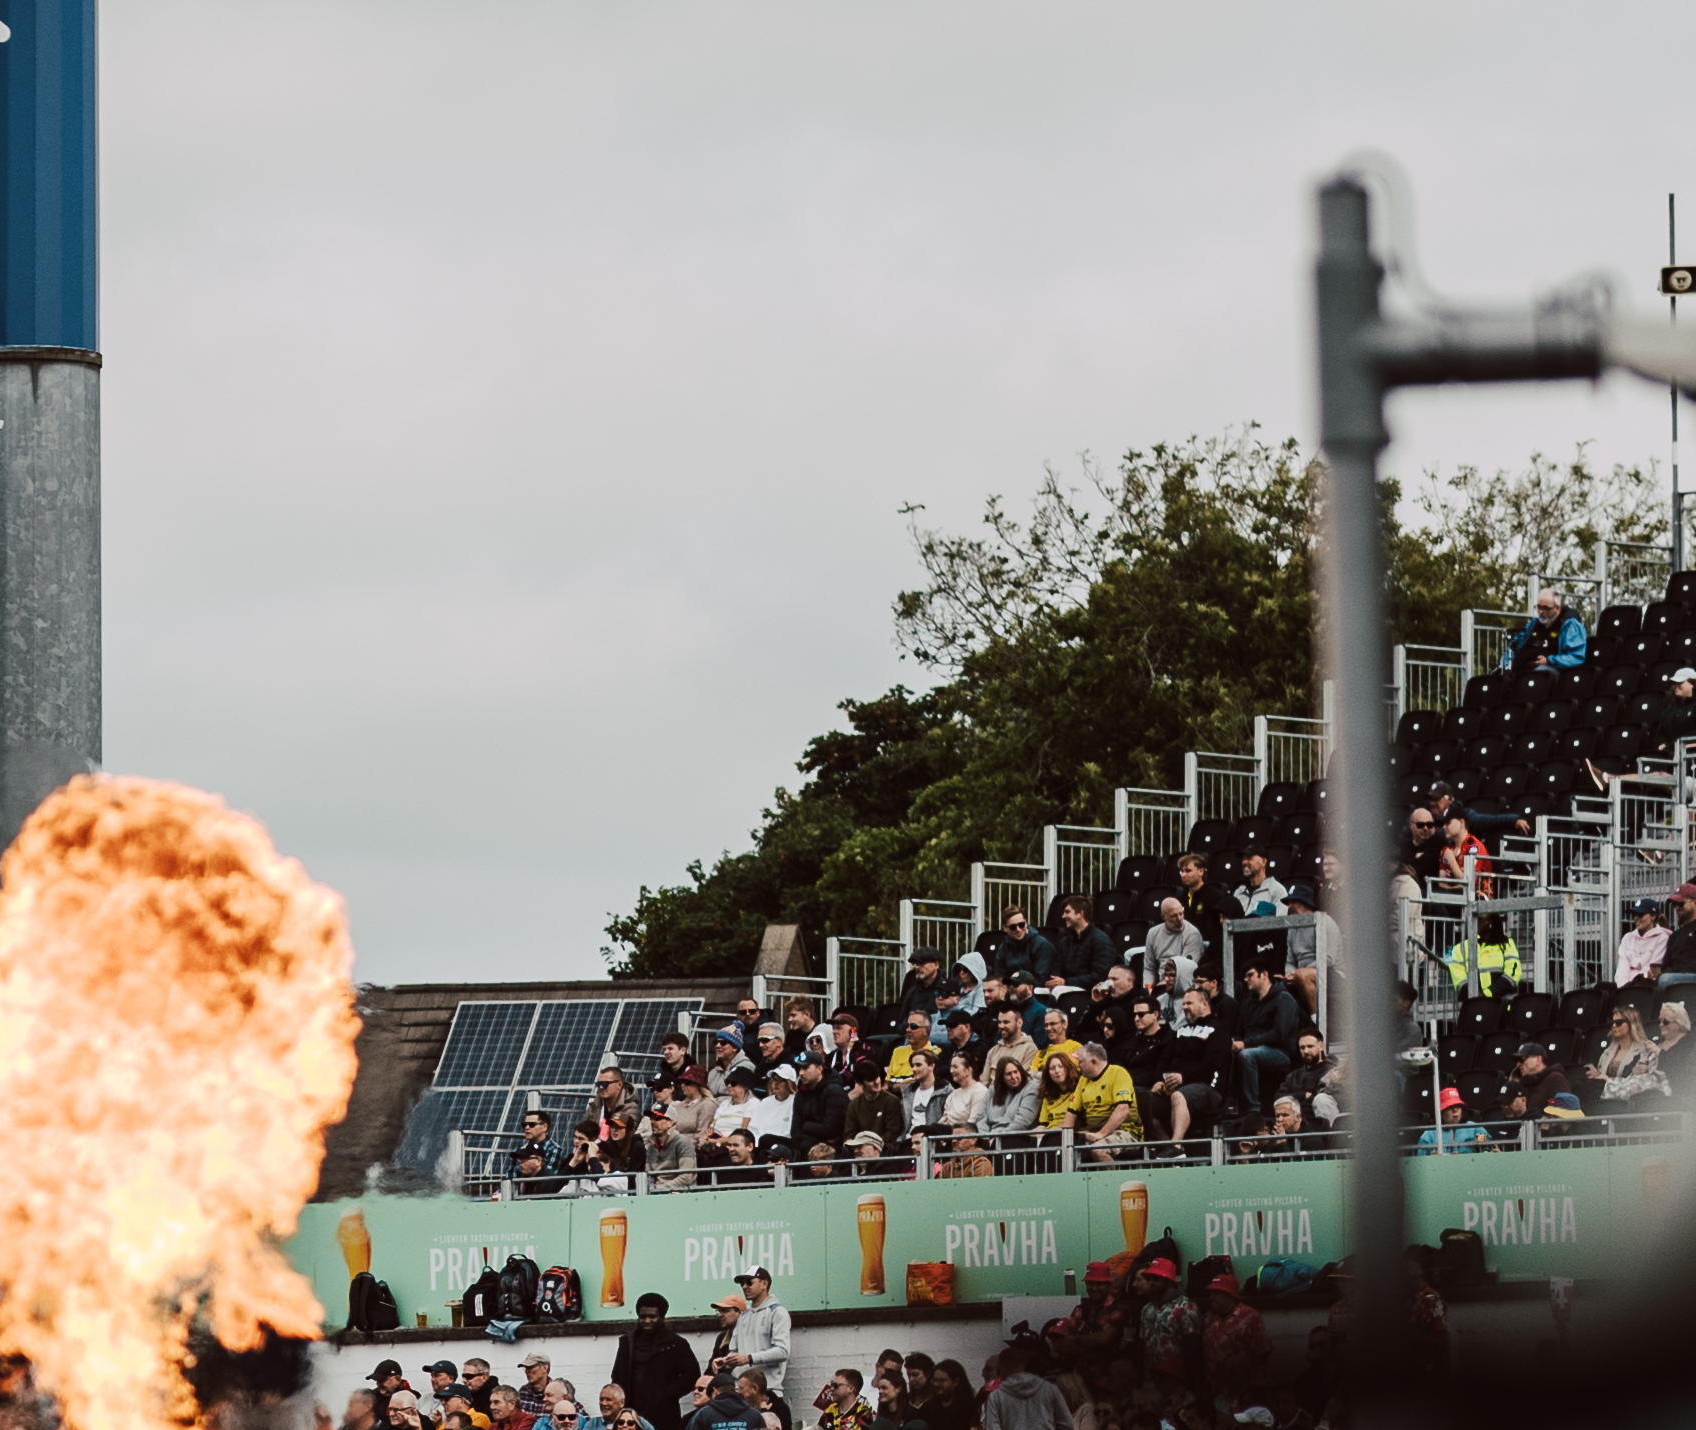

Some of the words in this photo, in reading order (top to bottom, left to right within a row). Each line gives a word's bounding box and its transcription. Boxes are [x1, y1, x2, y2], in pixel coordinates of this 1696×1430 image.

[945, 1219, 1058, 1269] PRAVHA
[1205, 1208, 1313, 1257] PRAVHA
[1463, 1197, 1578, 1246] PRAVHA
[684, 1232, 794, 1282] PRAVHA
